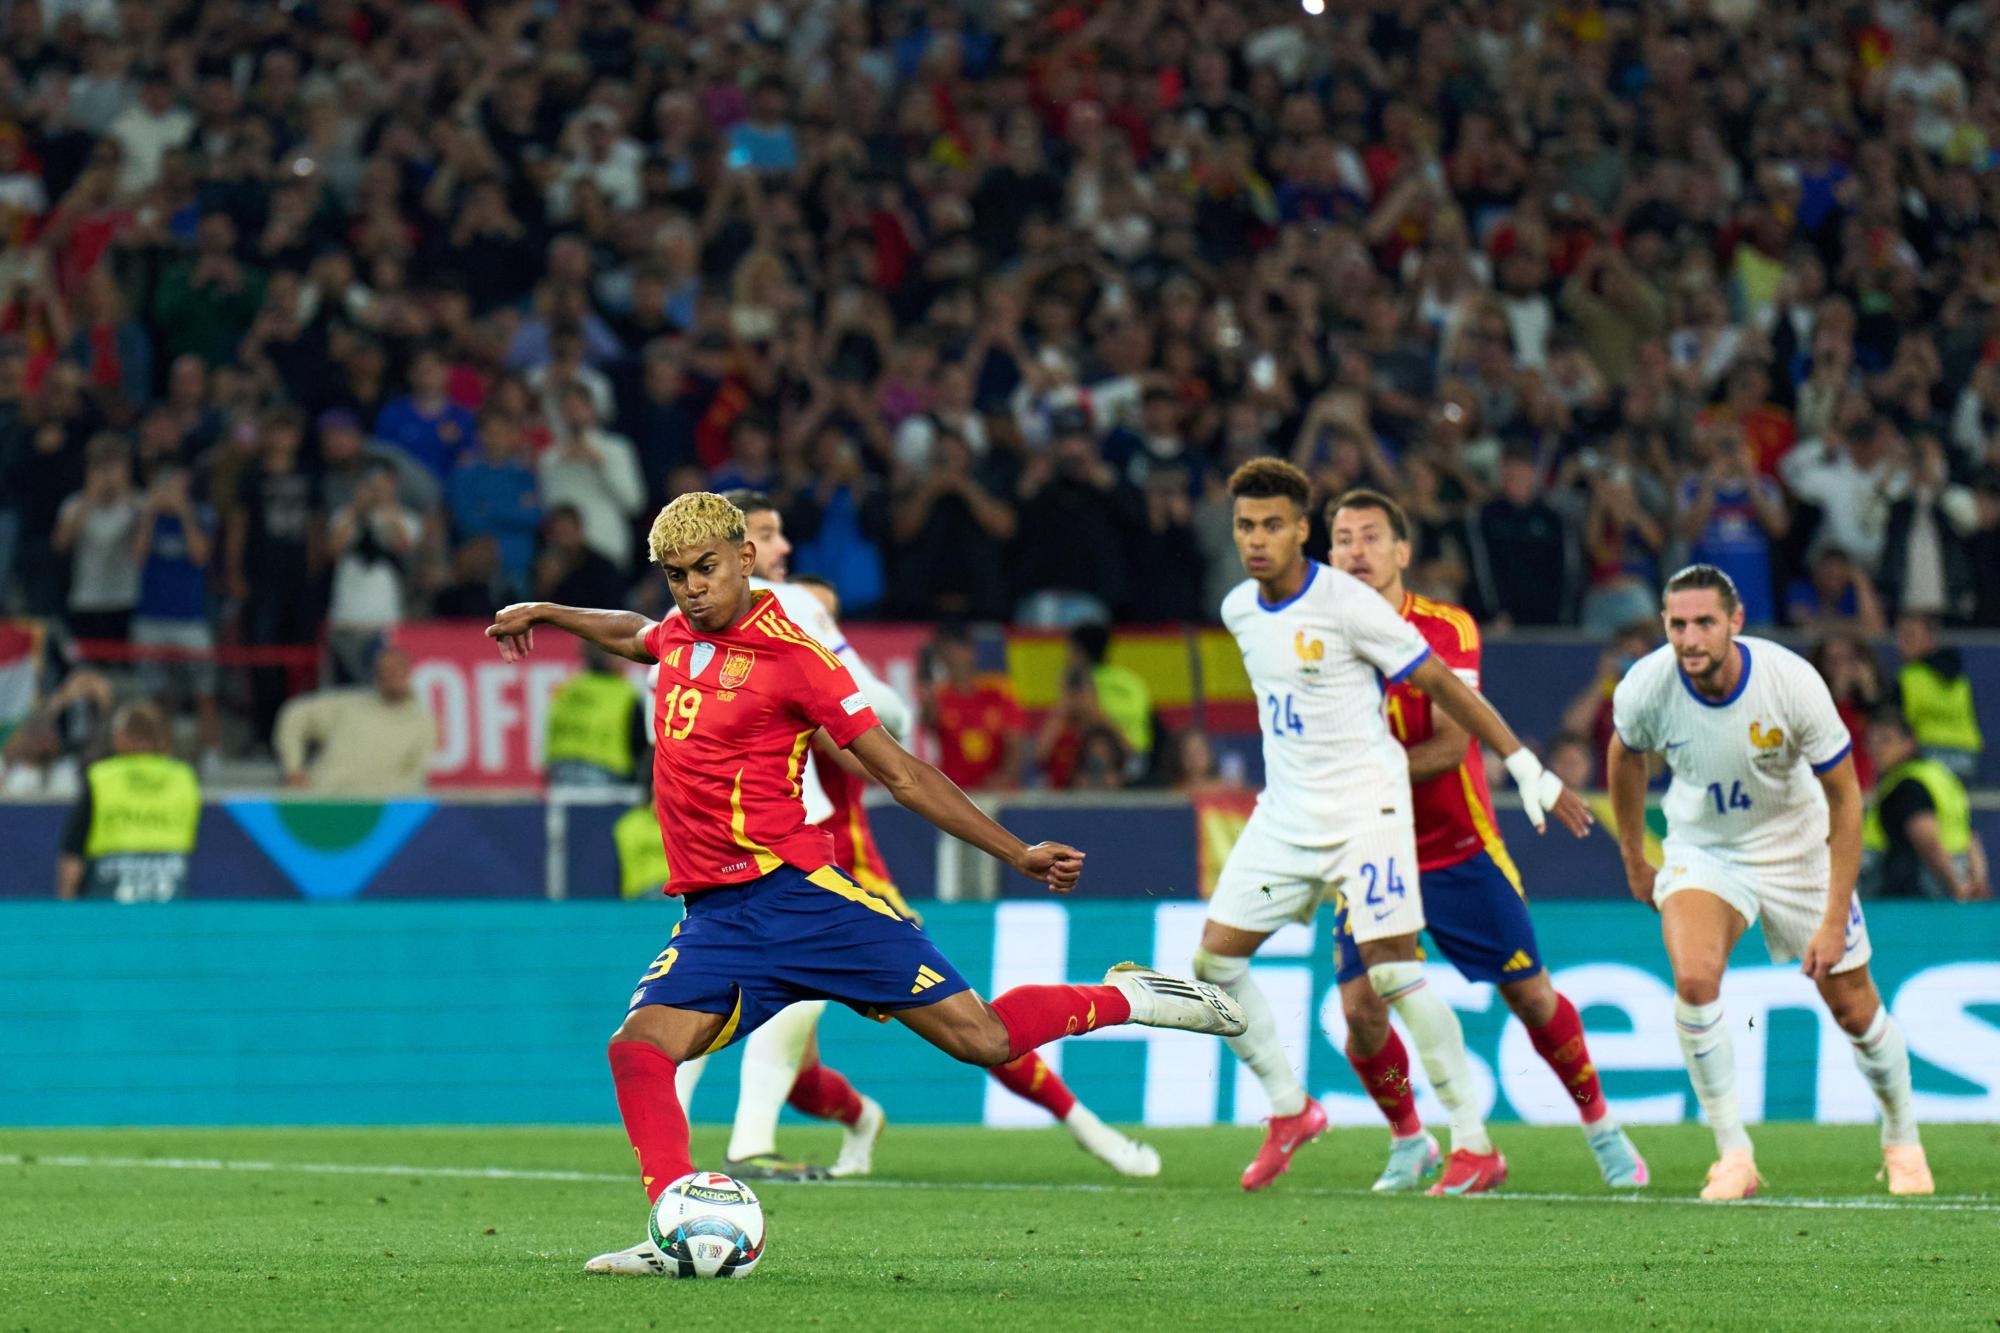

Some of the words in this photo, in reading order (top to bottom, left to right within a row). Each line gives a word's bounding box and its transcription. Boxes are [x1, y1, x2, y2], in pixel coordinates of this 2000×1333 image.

[664, 685, 702, 740] 19
[1268, 692, 1304, 736] 24
[1708, 780, 1752, 815] 14
[1360, 856, 1405, 906] 24
[1198, 986, 1240, 1024] F50
[690, 1187, 740, 1201] NATIONS
